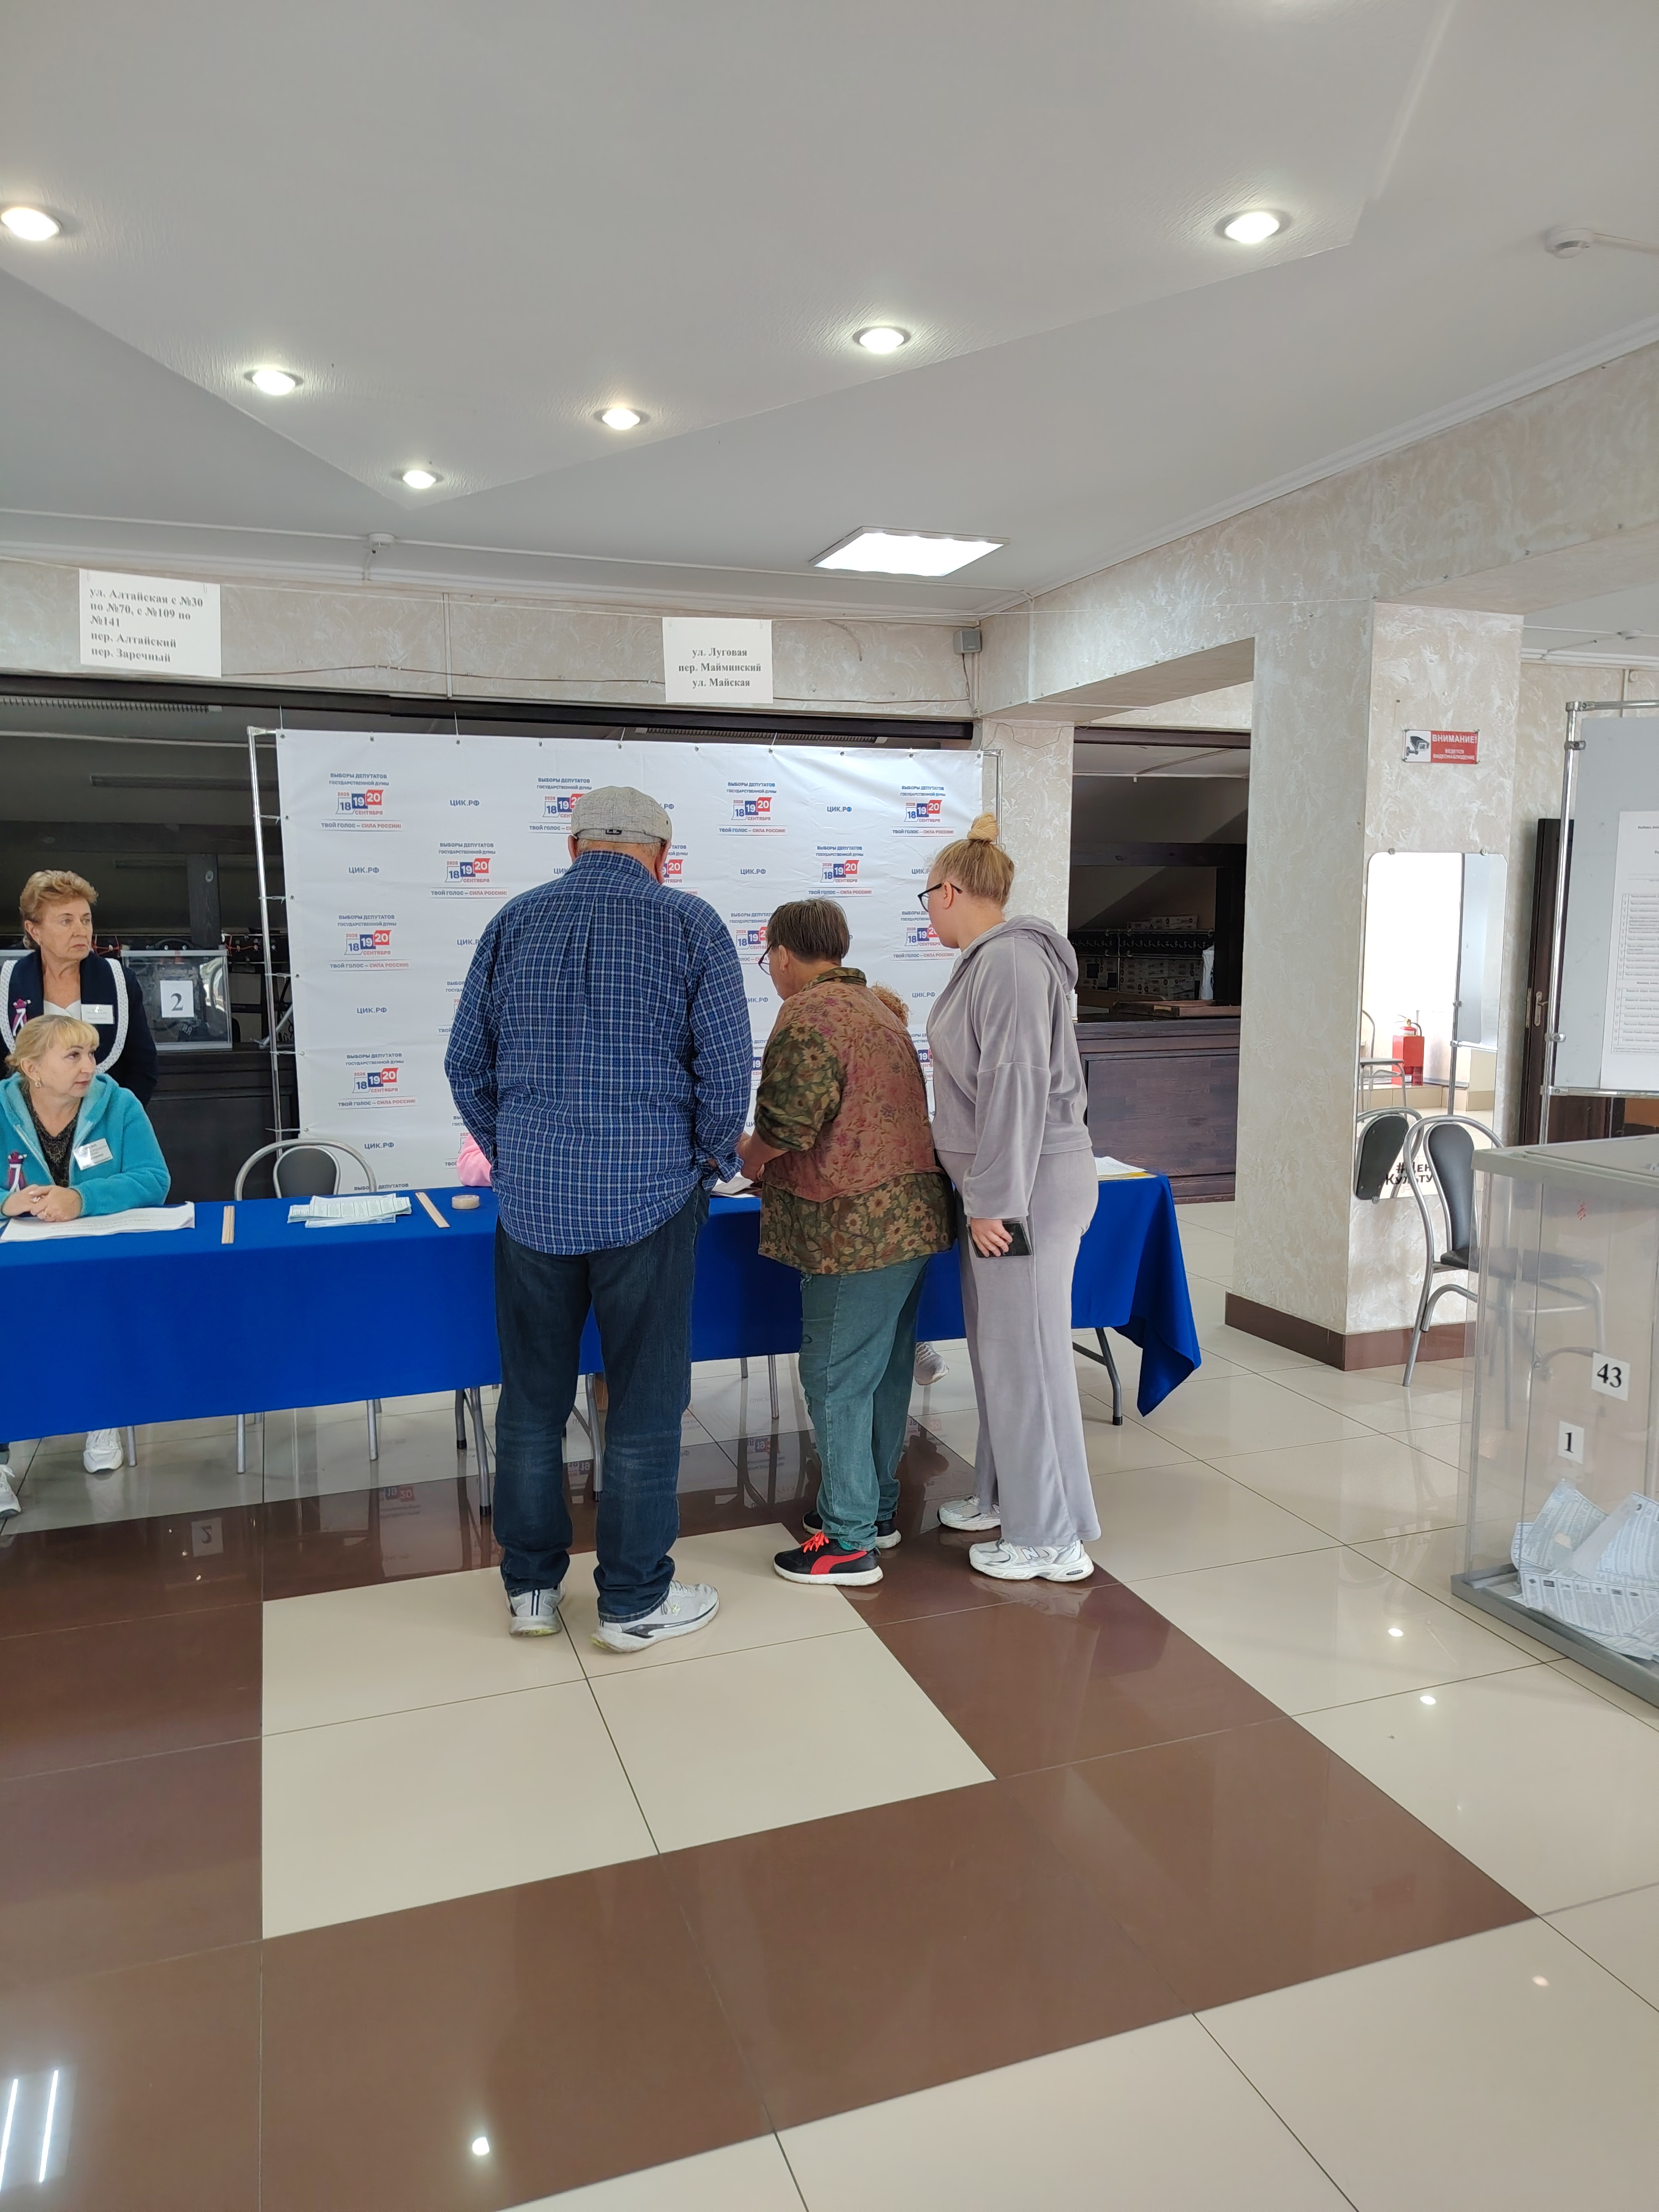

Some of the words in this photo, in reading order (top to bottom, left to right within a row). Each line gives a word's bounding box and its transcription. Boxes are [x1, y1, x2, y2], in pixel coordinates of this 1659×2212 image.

[90, 588, 106, 598] ул.
[109, 589, 168, 604] Алтайская
[179, 596, 203, 608] №30
[90, 603, 103, 611] по
[106, 603, 134, 615] №70,
[145, 607, 175, 618] №109
[179, 612, 191, 621] по
[90, 615, 120, 627] №141
[91, 632, 113, 643] пер.
[117, 633, 176, 648] Алтайский
[92, 648, 113, 659] пер.
[116, 648, 170, 662] Заречный
[692, 649, 706, 659] ул.
[708, 648, 747, 659] Луговая
[679, 665, 698, 674] пер.
[701, 663, 761, 672] Майминский
[692, 680, 706, 689] ул.
[709, 678, 750, 687] Майская
[1432, 734, 1477, 744] ВНИМАНИЕ!
[340, 802, 351, 811] 18
[353, 797, 364, 806] 19
[367, 792, 380, 802] 20
[546, 805, 556, 814] 18
[559, 801, 569, 810] 19
[746, 804, 755, 812] 19
[449, 870, 460, 879] 18
[461, 865, 472, 875] 19
[474, 861, 487, 870] 20
[669, 863, 680, 871] 20
[834, 867, 843, 875] 19
[845, 863, 856, 872] 20
[361, 937, 372, 947] 19
[374, 933, 388, 942] 20
[749, 933, 758, 942] 19
[918, 931, 927, 939] 19
[171, 993, 183, 1011] 2
[919, 1052, 927, 1061] 19
[356, 1082, 367, 1090] 18
[369, 1076, 380, 1085] 19
[382, 1071, 395, 1080] 20
[1597, 1363, 1622, 1387] 43
[1564, 1432, 1574, 1453] 1
[1021, 1546, 1040, 1561] N
